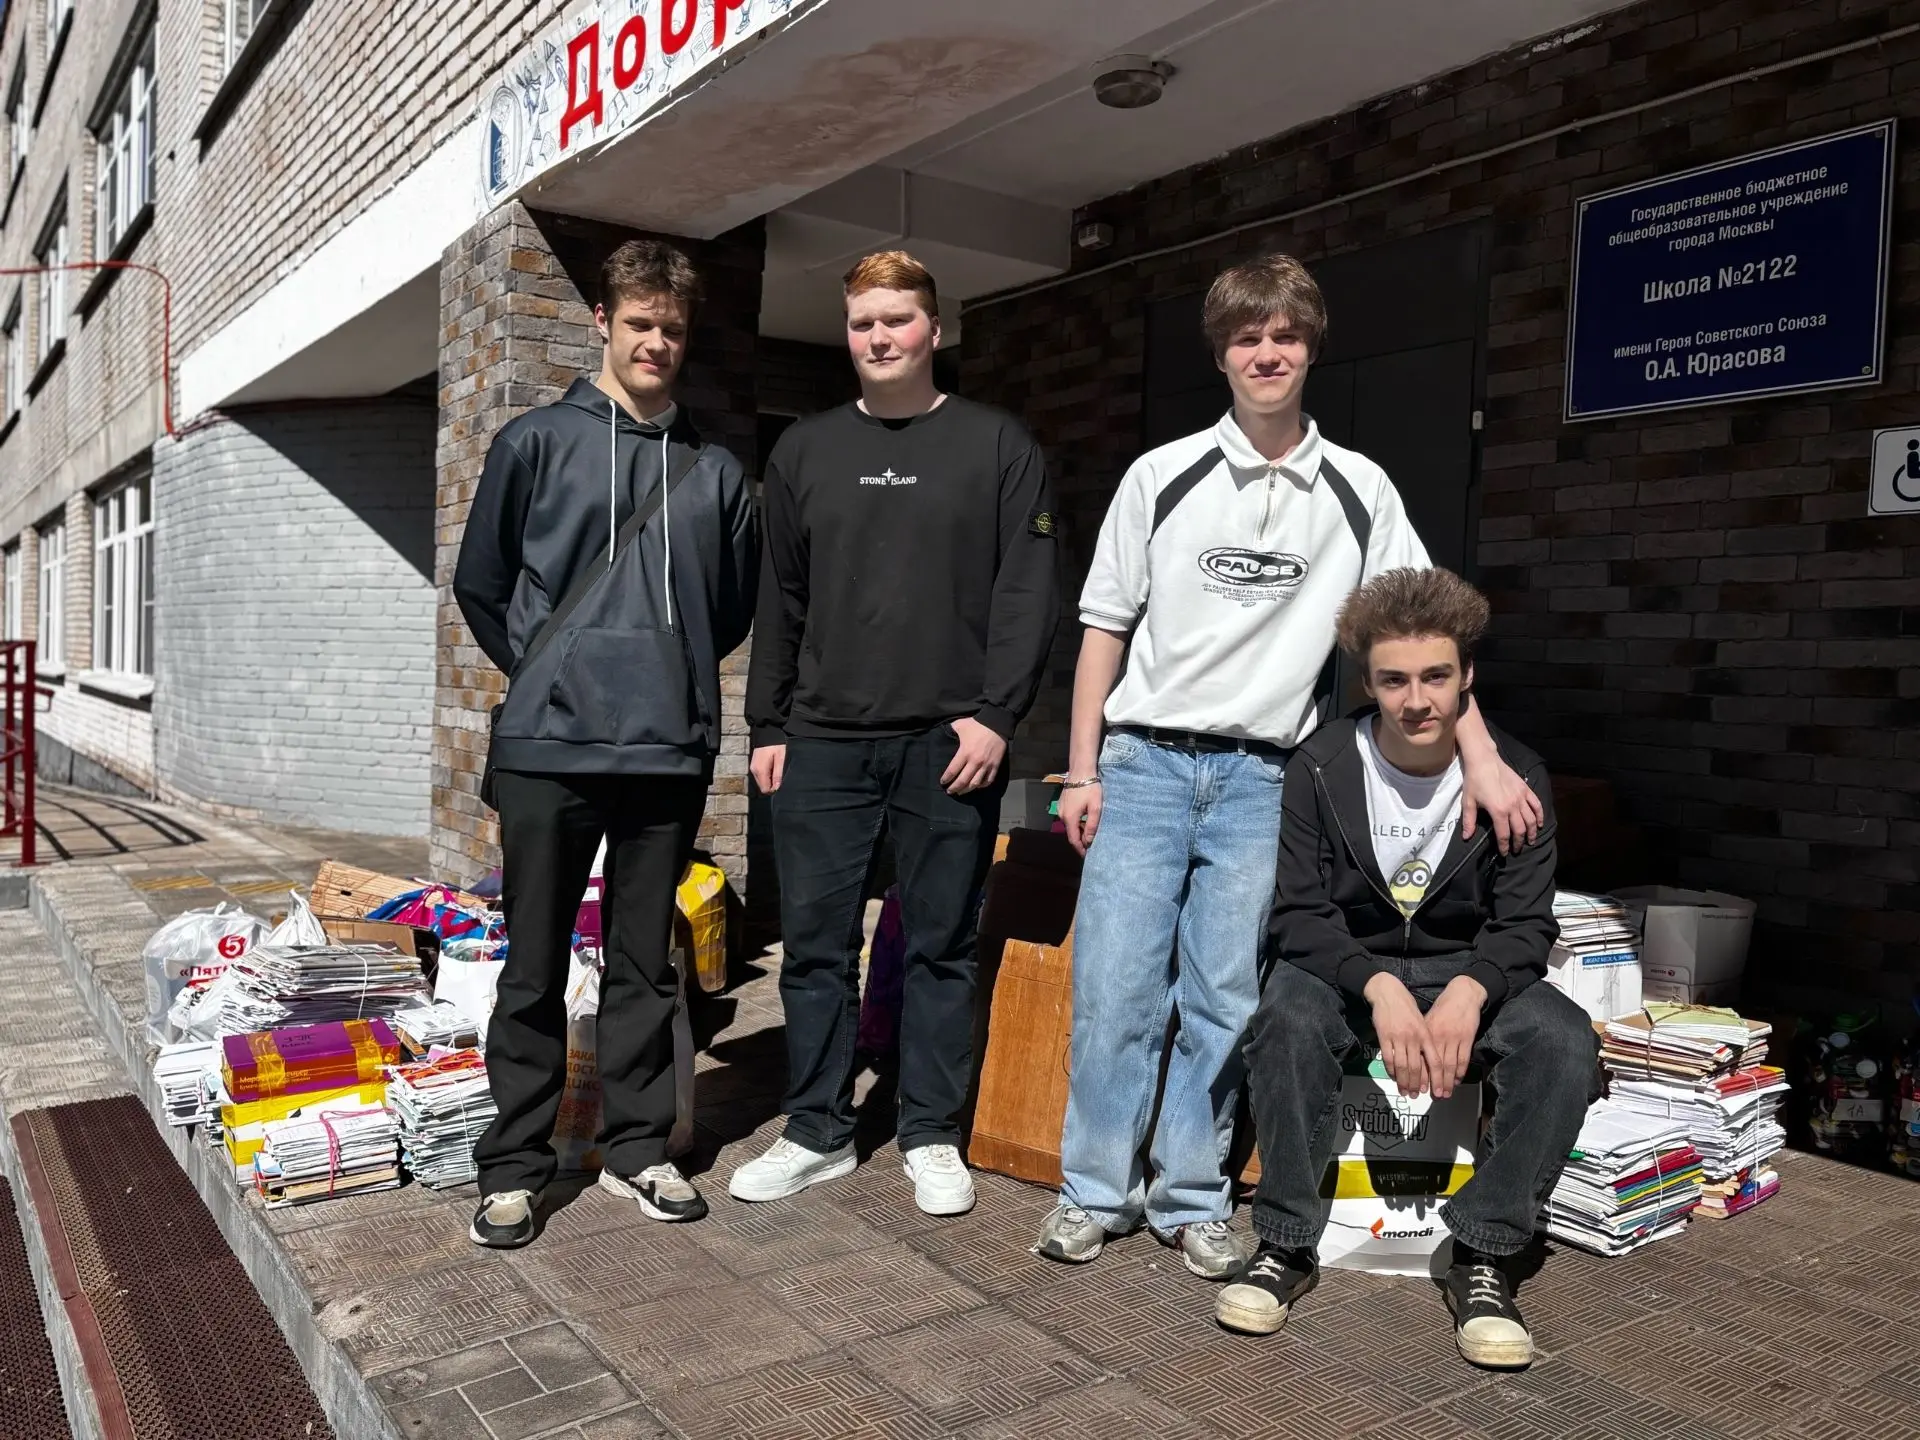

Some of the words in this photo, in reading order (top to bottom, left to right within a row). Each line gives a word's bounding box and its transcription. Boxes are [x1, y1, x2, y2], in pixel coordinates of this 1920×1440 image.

[1631, 186, 1742, 223] Государственное
[1746, 166, 1828, 196] бюджетное
[1608, 201, 1756, 246] общеобразовательное
[1760, 182, 1849, 215] учреждение
[1668, 231, 1715, 252] города
[1719, 218, 1774, 240] Москвы
[1643, 275, 1711, 303] Школа
[1718, 254, 1797, 289] №2122
[1614, 343, 1651, 358] имени
[1656, 336, 1692, 353] Героя
[1695, 322, 1773, 345] Советского
[1778, 314, 1827, 332] Союза
[1645, 357, 1681, 381] О.А.
[1687, 345, 1786, 376] Юрасова
[859, 476, 887, 485] STONE
[890, 476, 917, 486] ISLAND
[1214, 559, 1296, 577] PAUSE
[1417, 828, 1426, 838] 4
[1342, 1104, 1430, 1141] SvetoCopy
[1382, 1227, 1434, 1239] mondi
